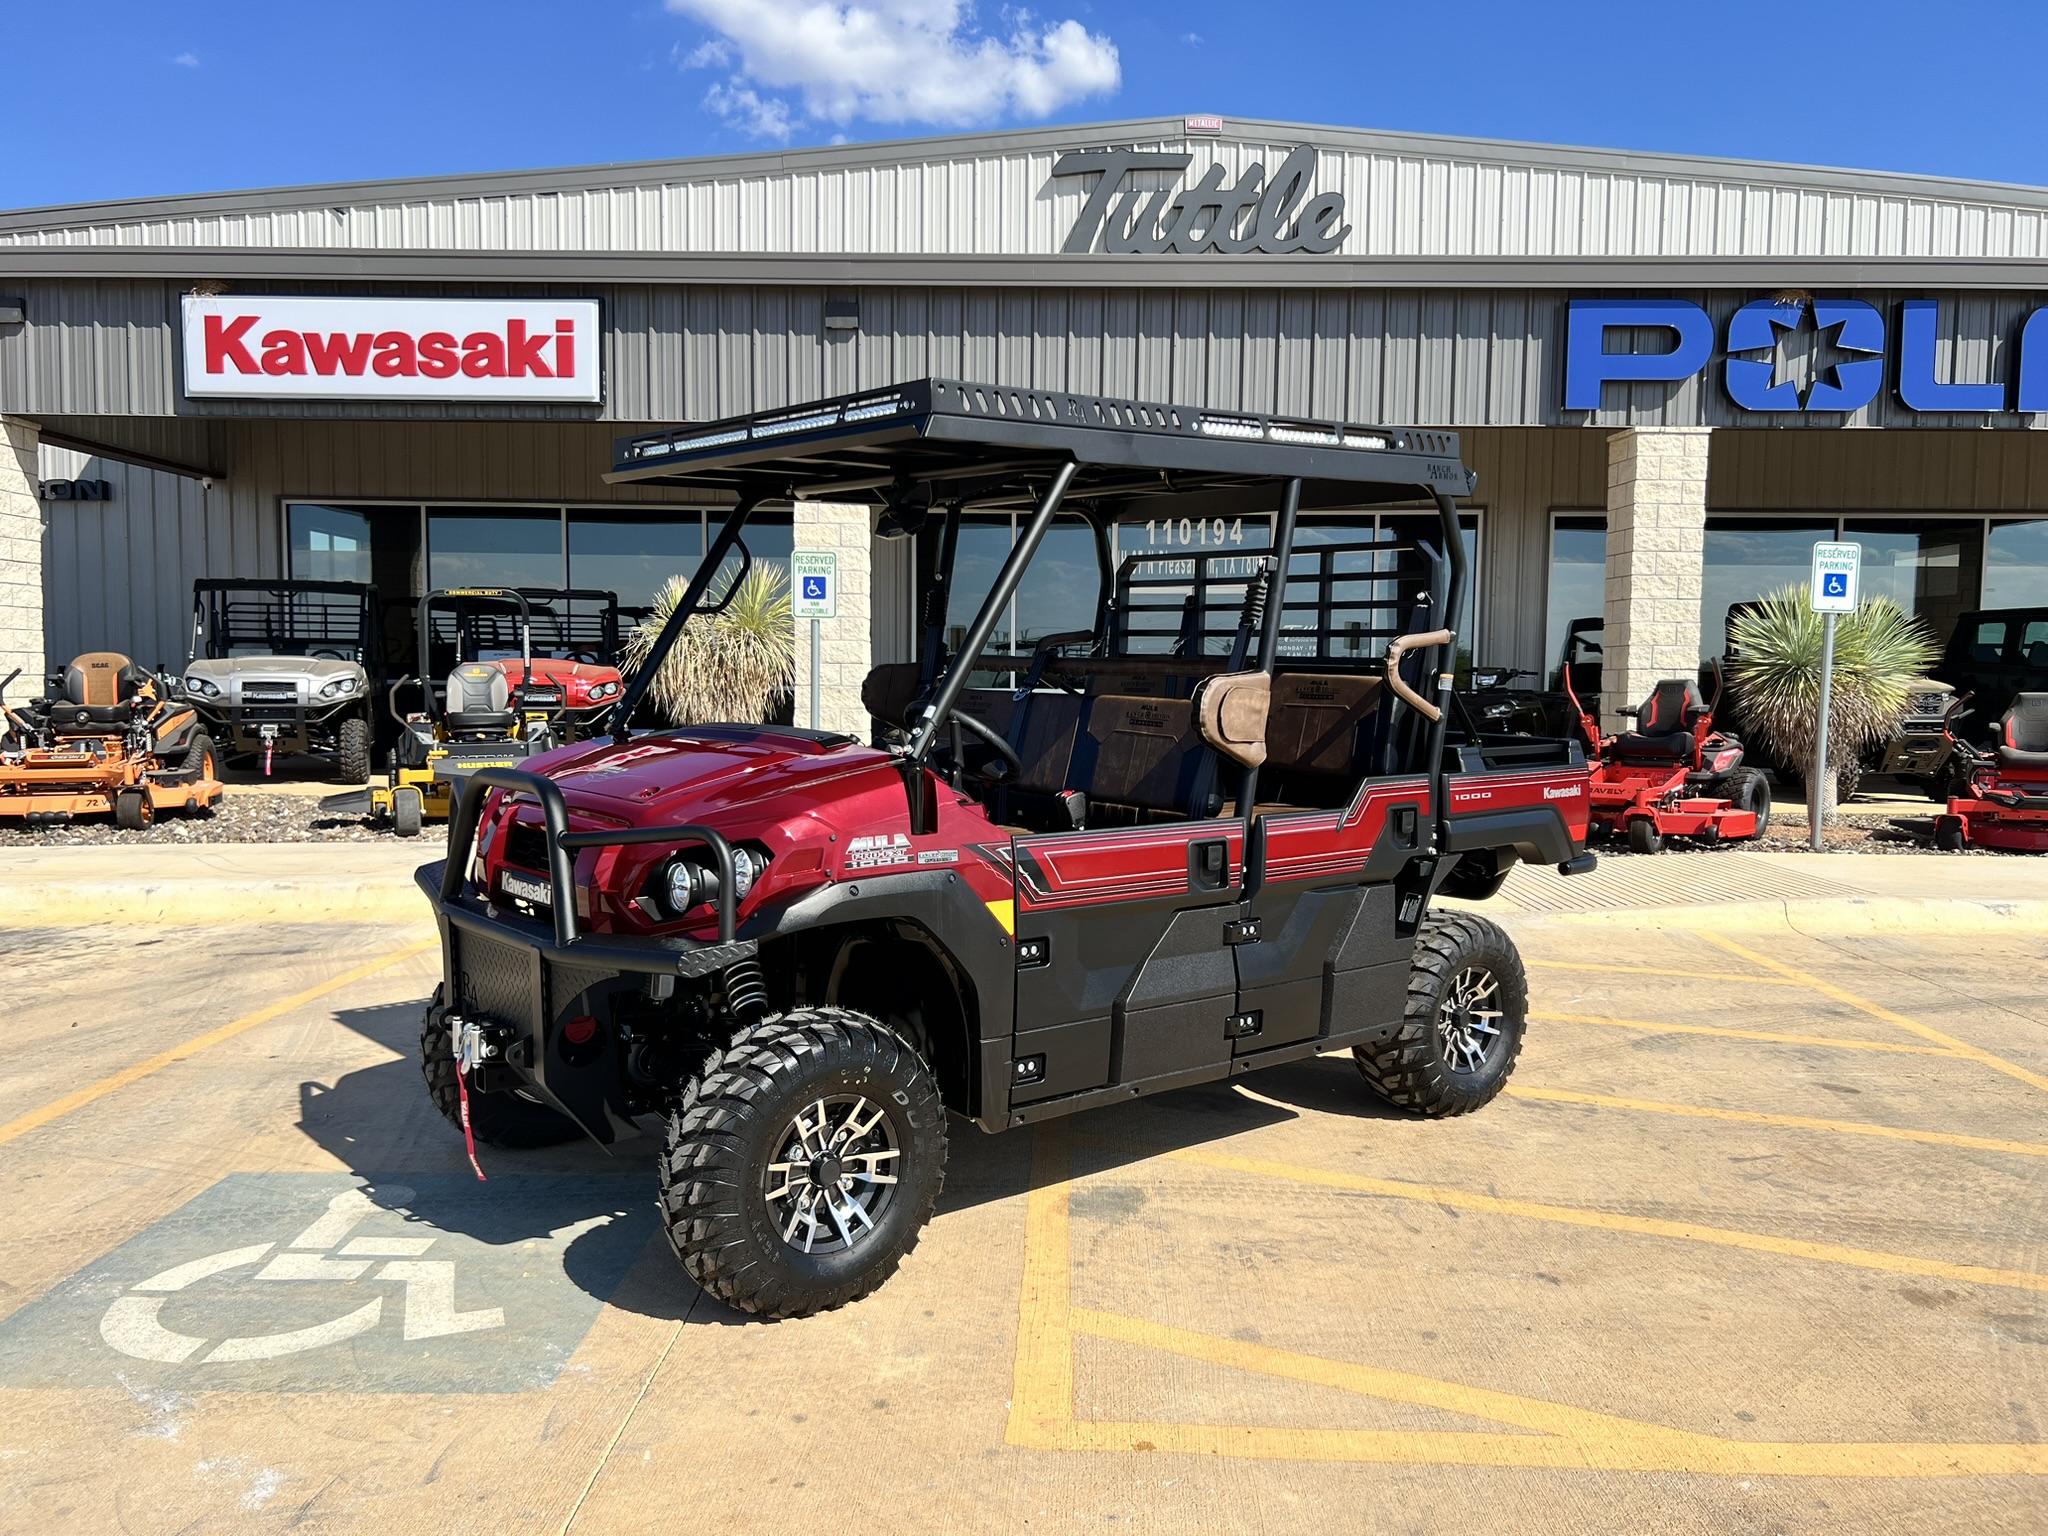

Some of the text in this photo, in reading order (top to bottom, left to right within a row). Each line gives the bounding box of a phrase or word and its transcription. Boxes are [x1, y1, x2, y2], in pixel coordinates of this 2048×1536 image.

[1052, 144, 1352, 253] Tuttle
[204, 315, 575, 378] Kawasaki
[1565, 299, 2048, 412] POL
[39, 479, 109, 500] ON
[1146, 518, 1243, 545] 110194
[795, 555, 834, 565] RESERVED
[1817, 549, 1857, 560] RESERVED
[798, 565, 832, 575] PARKING
[1820, 561, 1853, 571] PARKING
[457, 761, 513, 769] HUSTLER
[1455, 792, 1491, 800] 1000
[1543, 784, 1581, 799] Kawasaki
[86, 799, 99, 807] 72
[501, 871, 552, 905] Kawasaki
